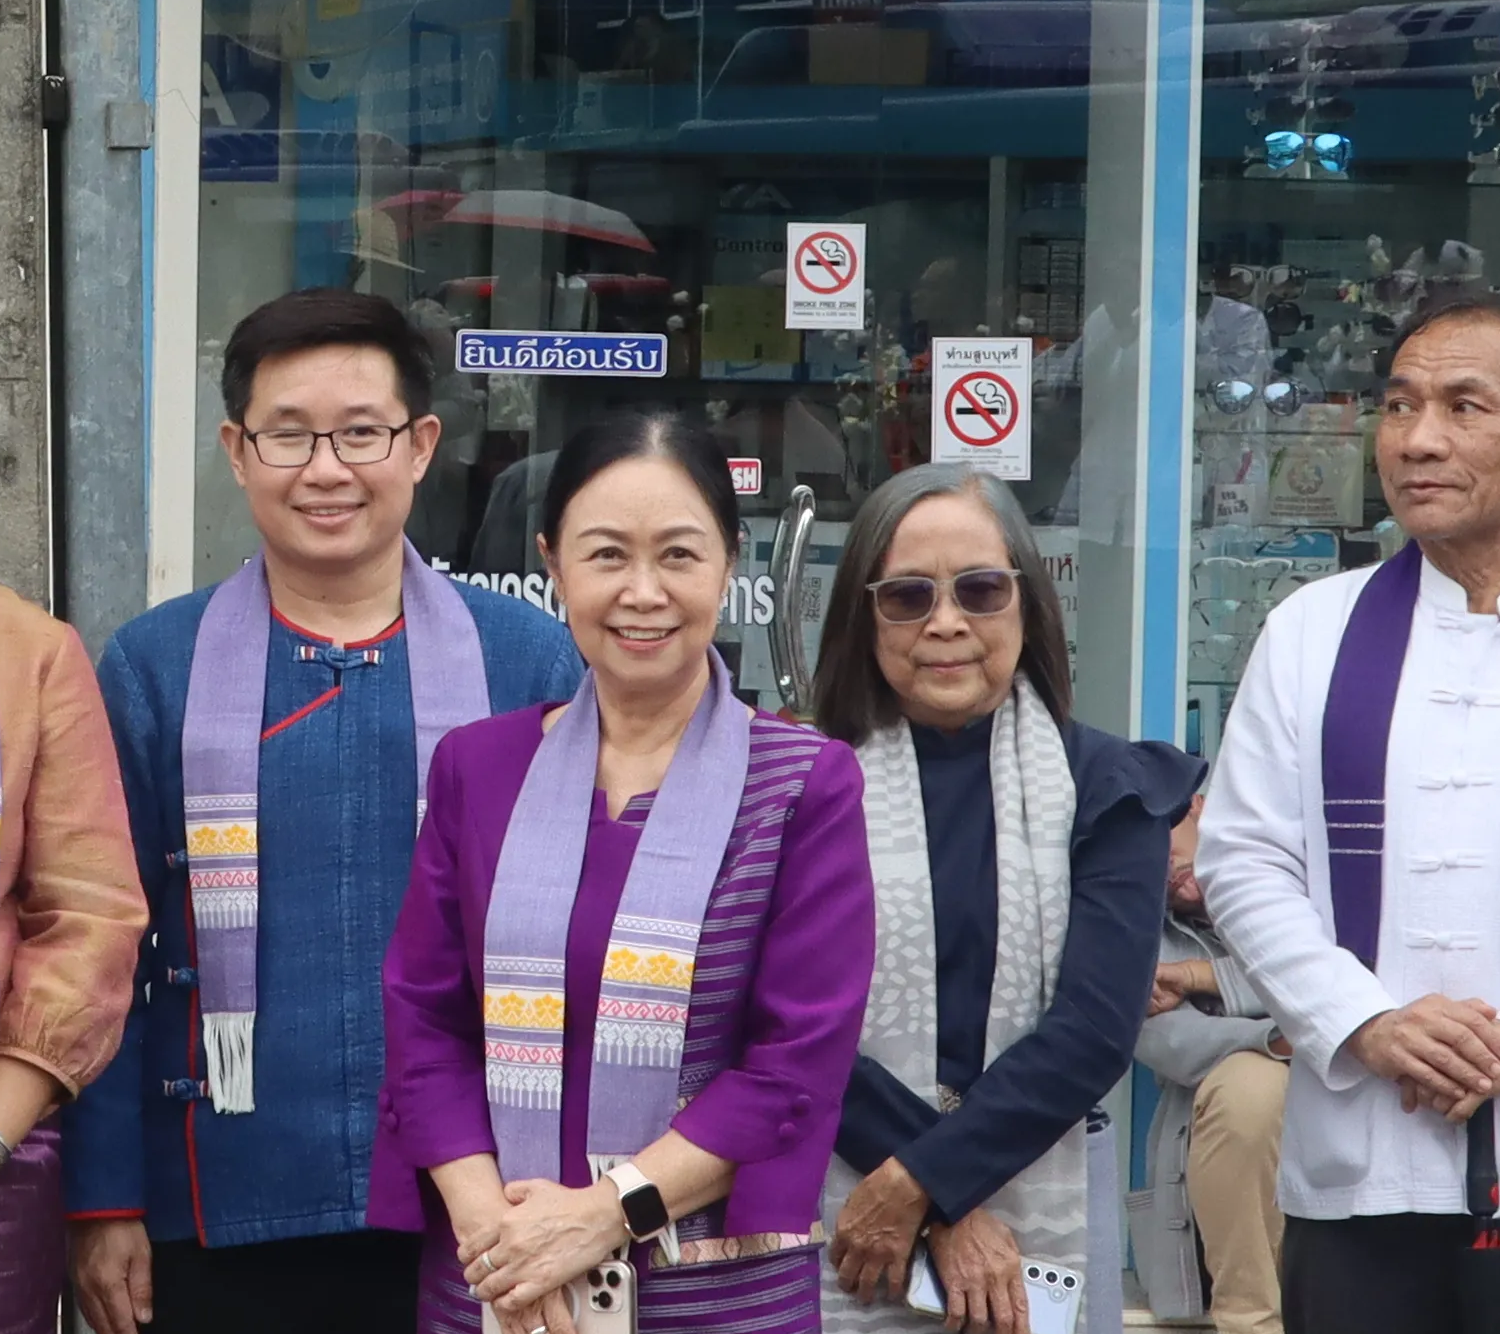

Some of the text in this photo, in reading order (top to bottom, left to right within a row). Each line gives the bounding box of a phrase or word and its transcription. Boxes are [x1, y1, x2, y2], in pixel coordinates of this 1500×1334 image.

[463, 338, 658, 371] ยินดีต้อนรับ
[945, 344, 1019, 364] ห้ามสูบบุหรี่
